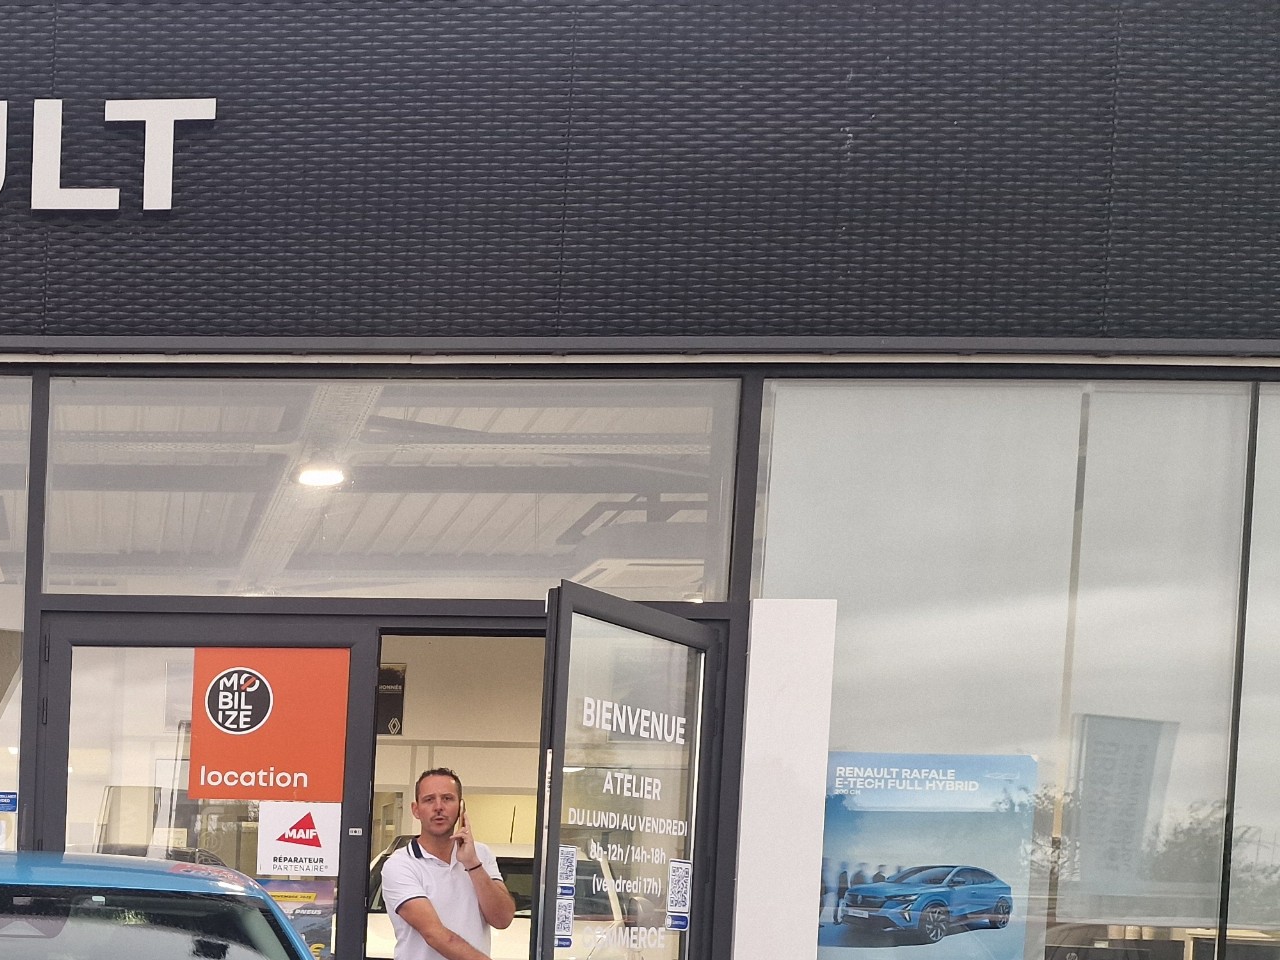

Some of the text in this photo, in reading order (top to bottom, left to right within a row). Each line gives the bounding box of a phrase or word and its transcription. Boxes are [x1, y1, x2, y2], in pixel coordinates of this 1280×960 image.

[582, 696, 687, 745] BIENVENUE
[200, 765, 308, 788] location
[836, 766, 956, 780] RENAULT RAFALE
[602, 771, 662, 801] ATELIER
[835, 777, 980, 792] E-TECH FULL HYBRID
[568, 807, 688, 836] DU LUNDI AU VENDREDI
[284, 828, 318, 840] MAIF
[272, 855, 324, 864] RÉPARATEUR
[642, 878, 662, 898] 17h)
[583, 925, 666, 949] COMMERCE
